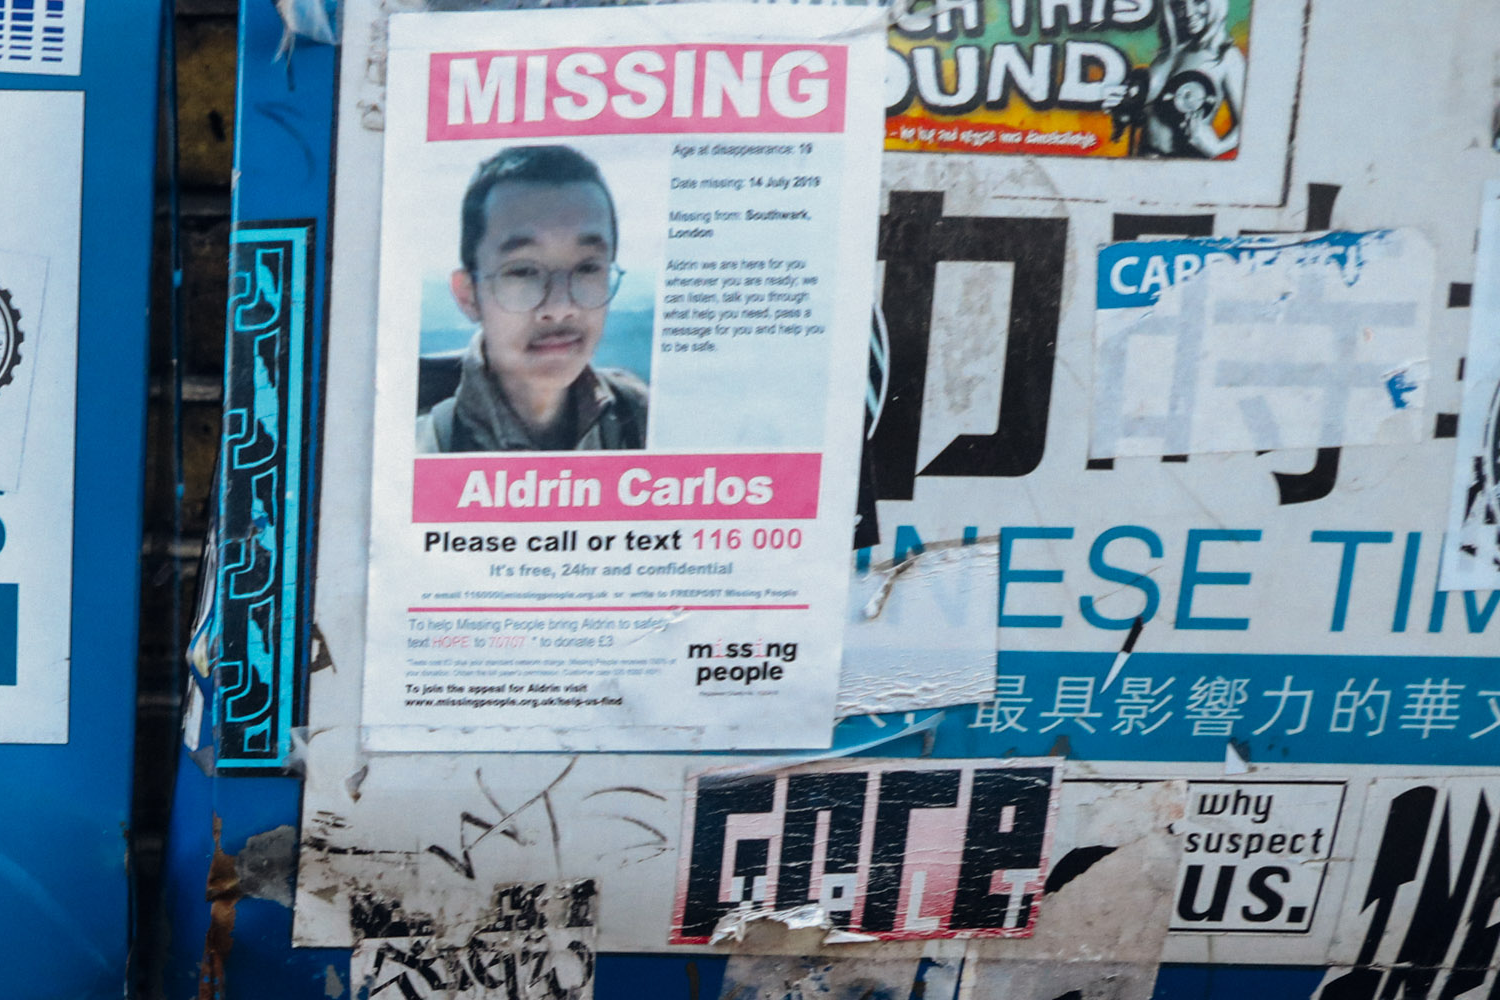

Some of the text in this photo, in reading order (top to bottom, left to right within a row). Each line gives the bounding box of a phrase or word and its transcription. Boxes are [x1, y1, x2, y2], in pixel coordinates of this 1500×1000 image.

[447, 50, 831, 126] MISSING
[672, 143, 813, 158] Age at disappearance: 19
[671, 176, 821, 190] Date missing: 14 July 2019
[668, 209, 811, 224] Missing from: Southwark,
[668, 228, 714, 239] London
[666, 258, 806, 272] Aldrin we are here for you
[665, 277, 719, 287] whenever
[720, 277, 742, 289] you
[744, 277, 763, 286] are
[802, 276, 819, 285] we
[665, 294, 685, 303] can
[721, 291, 743, 302] talk
[744, 293, 766, 305] you
[768, 291, 810, 304] through
[663, 309, 690, 320] what
[692, 309, 716, 321] help
[718, 310, 739, 322] you
[774, 309, 802, 320] pass
[804, 308, 812, 318] a
[662, 324, 826, 338] message for you and help you
[661, 341, 673, 352] to
[674, 341, 690, 352] be
[456, 466, 775, 508] Aldrin Carlos
[424, 528, 803, 552] Please call or text 116 000
[489, 562, 733, 579] It's free, 24hr and confidential
[409, 618, 424, 631] To
[427, 618, 453, 633] help
[456, 618, 500, 633] Missing
[504, 617, 545, 632] People
[548, 617, 579, 632] bring
[581, 617, 615, 630] Aldrin
[617, 618, 632, 630] to
[407, 635, 430, 648] text
[431, 635, 471, 648] HOPE
[474, 636, 486, 648] to
[540, 636, 553, 648] to
[554, 636, 595, 648] donate
[598, 635, 614, 648] £3
[687, 638, 798, 662] missing
[696, 661, 785, 686] people
[405, 683, 588, 695] To join the appeal for Aldrin visit
[1197, 788, 1275, 824] why
[1184, 826, 1326, 856] suspect
